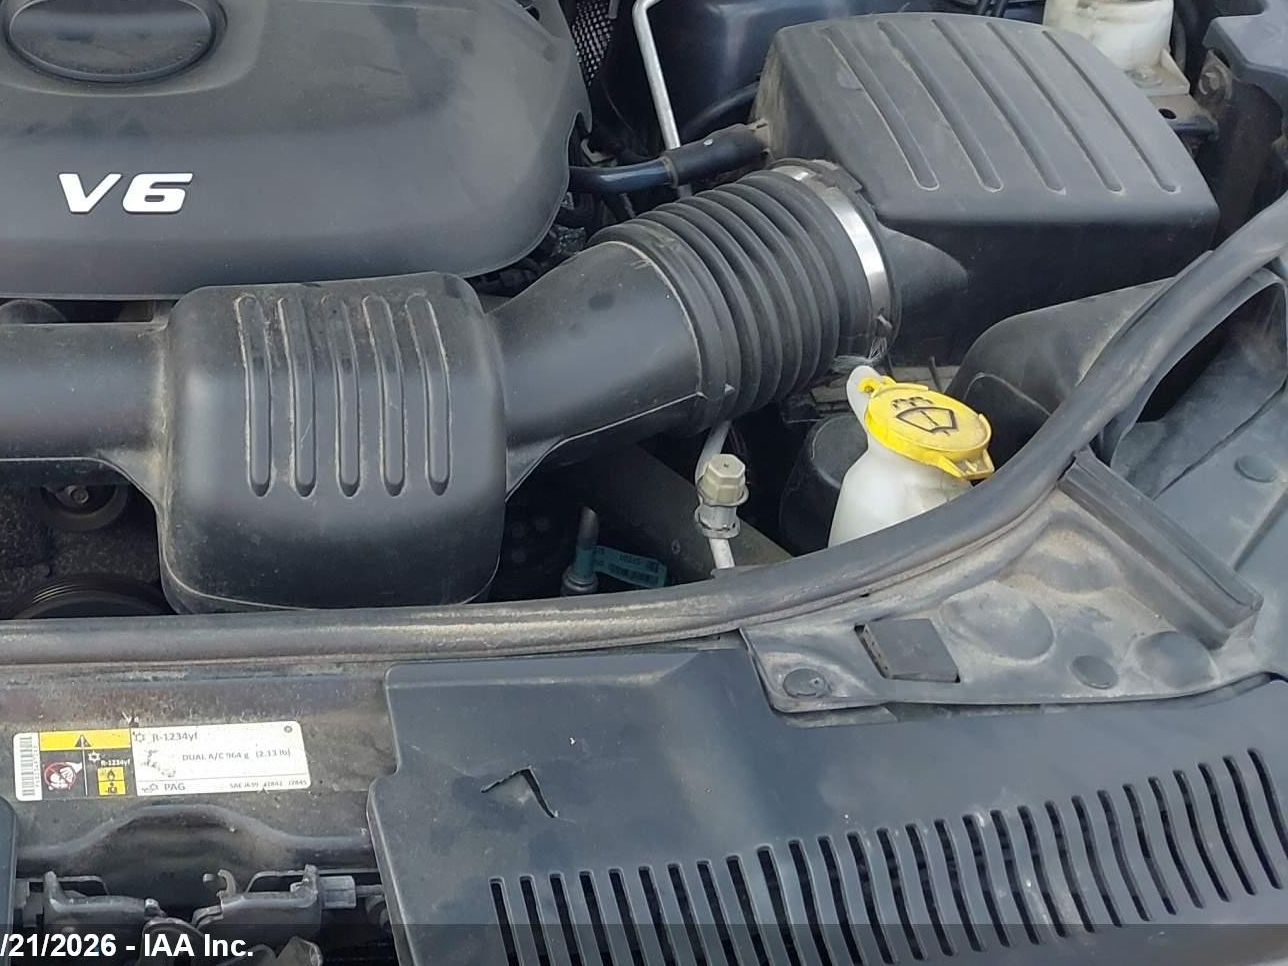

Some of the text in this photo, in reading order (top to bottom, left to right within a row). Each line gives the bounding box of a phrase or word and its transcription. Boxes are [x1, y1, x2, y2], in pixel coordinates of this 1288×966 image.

[58, 172, 194, 213] V6
[152, 731, 198, 742] R-1234yf
[182, 753, 206, 761] DUAL
[208, 751, 224, 761] A/C
[164, 781, 186, 792] PAG
